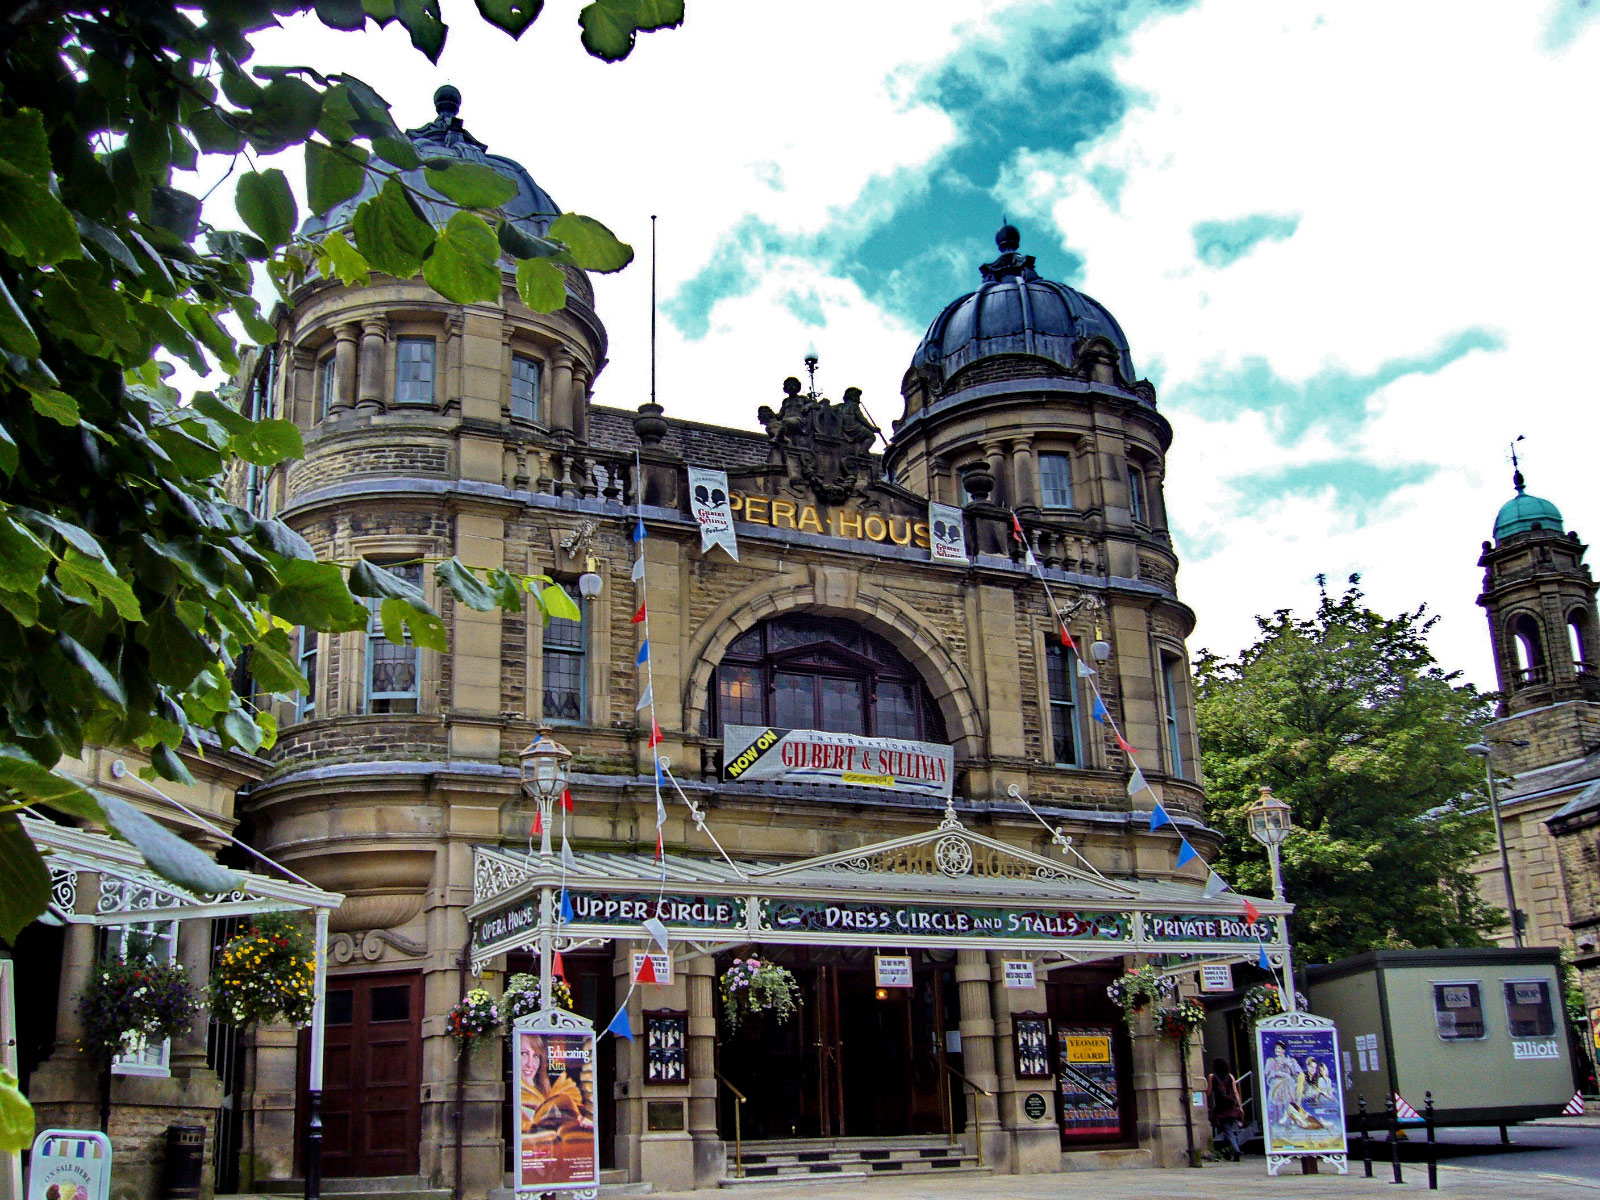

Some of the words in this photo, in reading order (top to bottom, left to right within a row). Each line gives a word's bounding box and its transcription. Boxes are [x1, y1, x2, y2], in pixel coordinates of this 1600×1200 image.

[698, 509, 725, 518] GILBERT
[729, 491, 823, 533] PERA
[839, 510, 931, 549] HOUS
[727, 746, 759, 777] NOW
[756, 730, 778, 751] ON
[809, 734, 925, 754] INTERNATIONAL
[781, 741, 857, 771] GILBERT
[861, 750, 872, 770] &
[878, 749, 947, 783] SULLIVAN
[871, 846, 939, 876] OPERA
[973, 846, 1034, 881] HOUSE
[576, 897, 648, 920] UPPER
[656, 899, 729, 922] CIRCLE
[825, 906, 890, 929] DRESS
[896, 909, 968, 931] CIRCLE
[974, 917, 1003, 930] AND
[1007, 913, 1078, 933] STALLS
[482, 919, 508, 941] OPERA
[508, 906, 533, 932] HOUSE
[1153, 918, 1216, 937] PRIVATE
[1220, 919, 1269, 938] BOXES
[547, 1045, 591, 1064] Educating
[1073, 1052, 1104, 1060] GUARD
[1512, 1041, 1559, 1057] Elliott
[548, 1058, 566, 1071] Rita
[45, 1170, 56, 1183] ON
[56, 1163, 73, 1174] SALE
[74, 1165, 92, 1185] HERE
